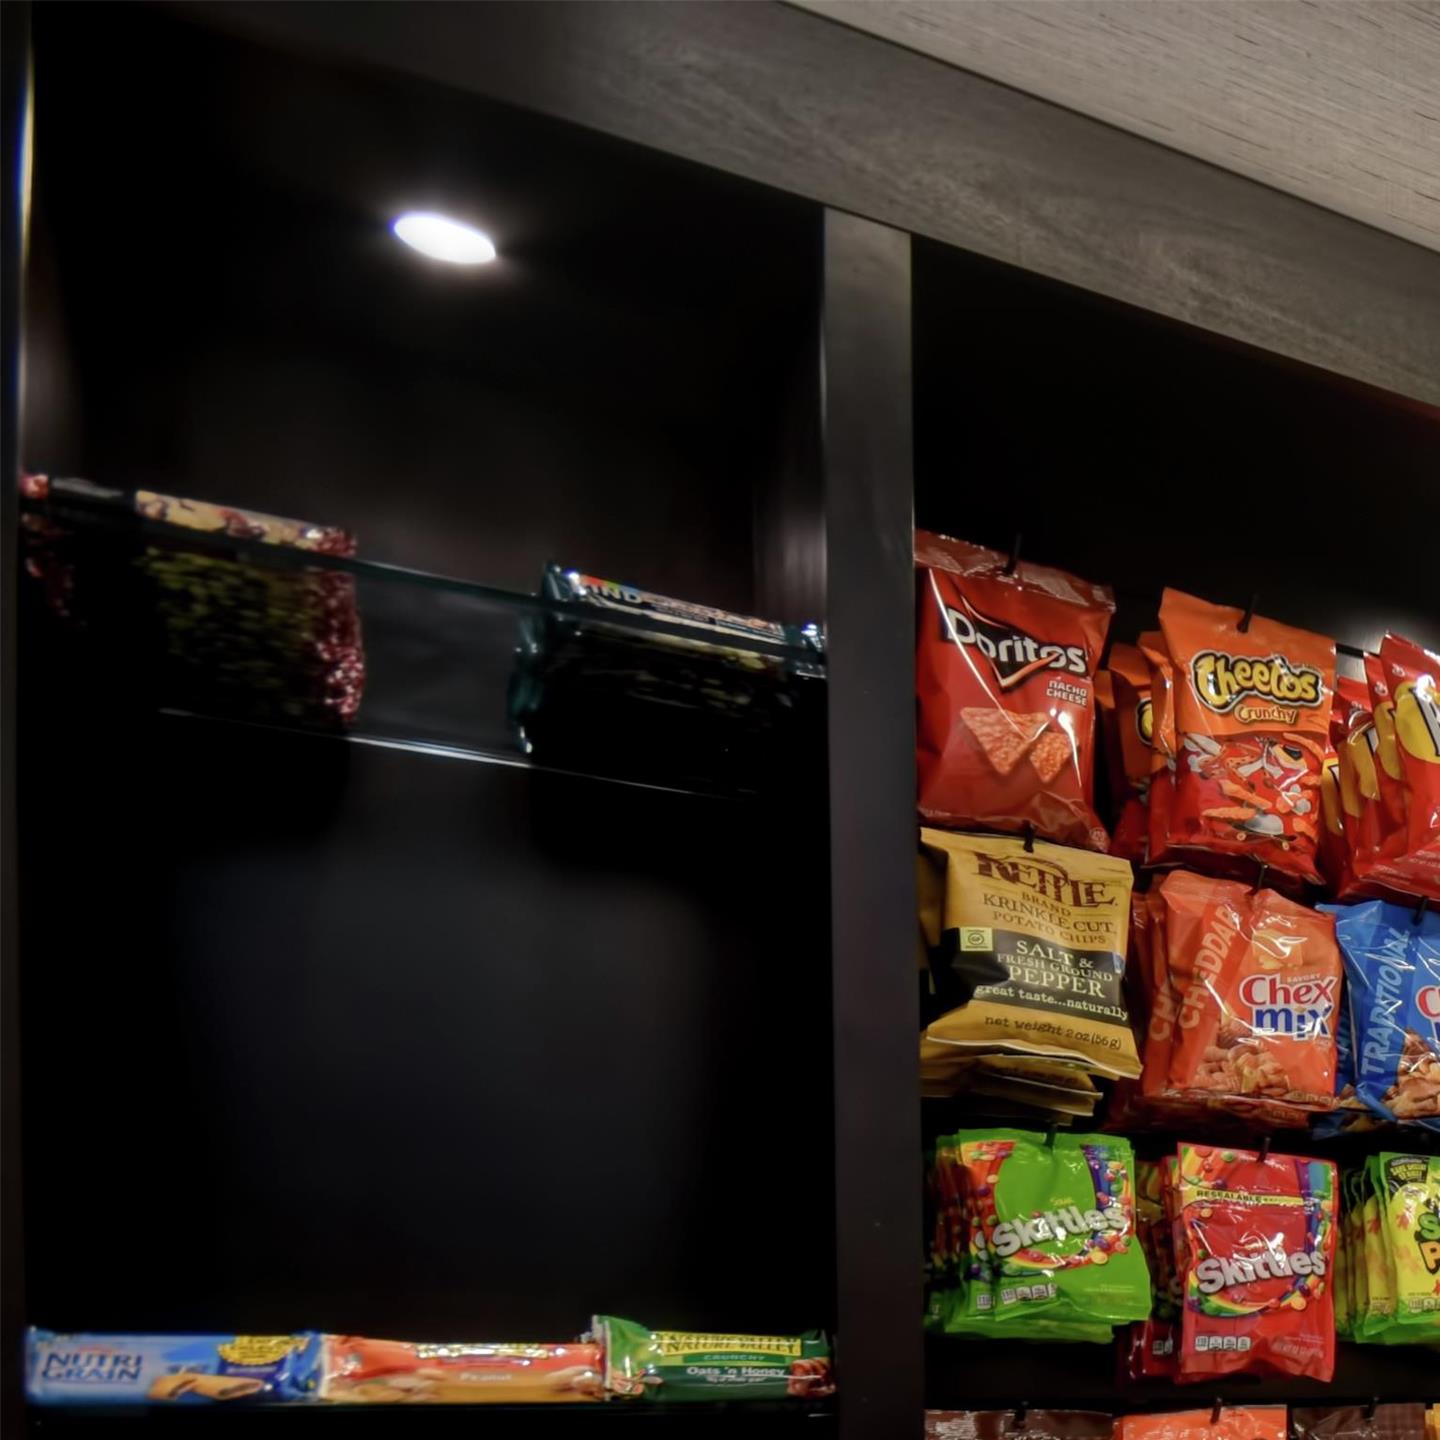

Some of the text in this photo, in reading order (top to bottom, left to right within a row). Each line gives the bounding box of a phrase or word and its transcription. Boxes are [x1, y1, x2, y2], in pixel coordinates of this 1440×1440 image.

[946, 607, 1087, 673] Doritos
[1046, 687, 1088, 706] CHEESE
[1048, 680, 1088, 698] NACHO
[1193, 653, 1322, 709] Cheetos
[1234, 705, 1297, 724] Crunchy
[976, 851, 1116, 908] KETTLE
[1016, 940, 1093, 968] SALT &
[1008, 966, 1105, 998] PEPPER
[1239, 973, 1338, 1007] Chex
[1014, 1019, 1063, 1036] weight
[1253, 1005, 1332, 1040] mix
[992, 1205, 1128, 1257] Skittles
[1196, 1250, 1328, 1294] Skittles
